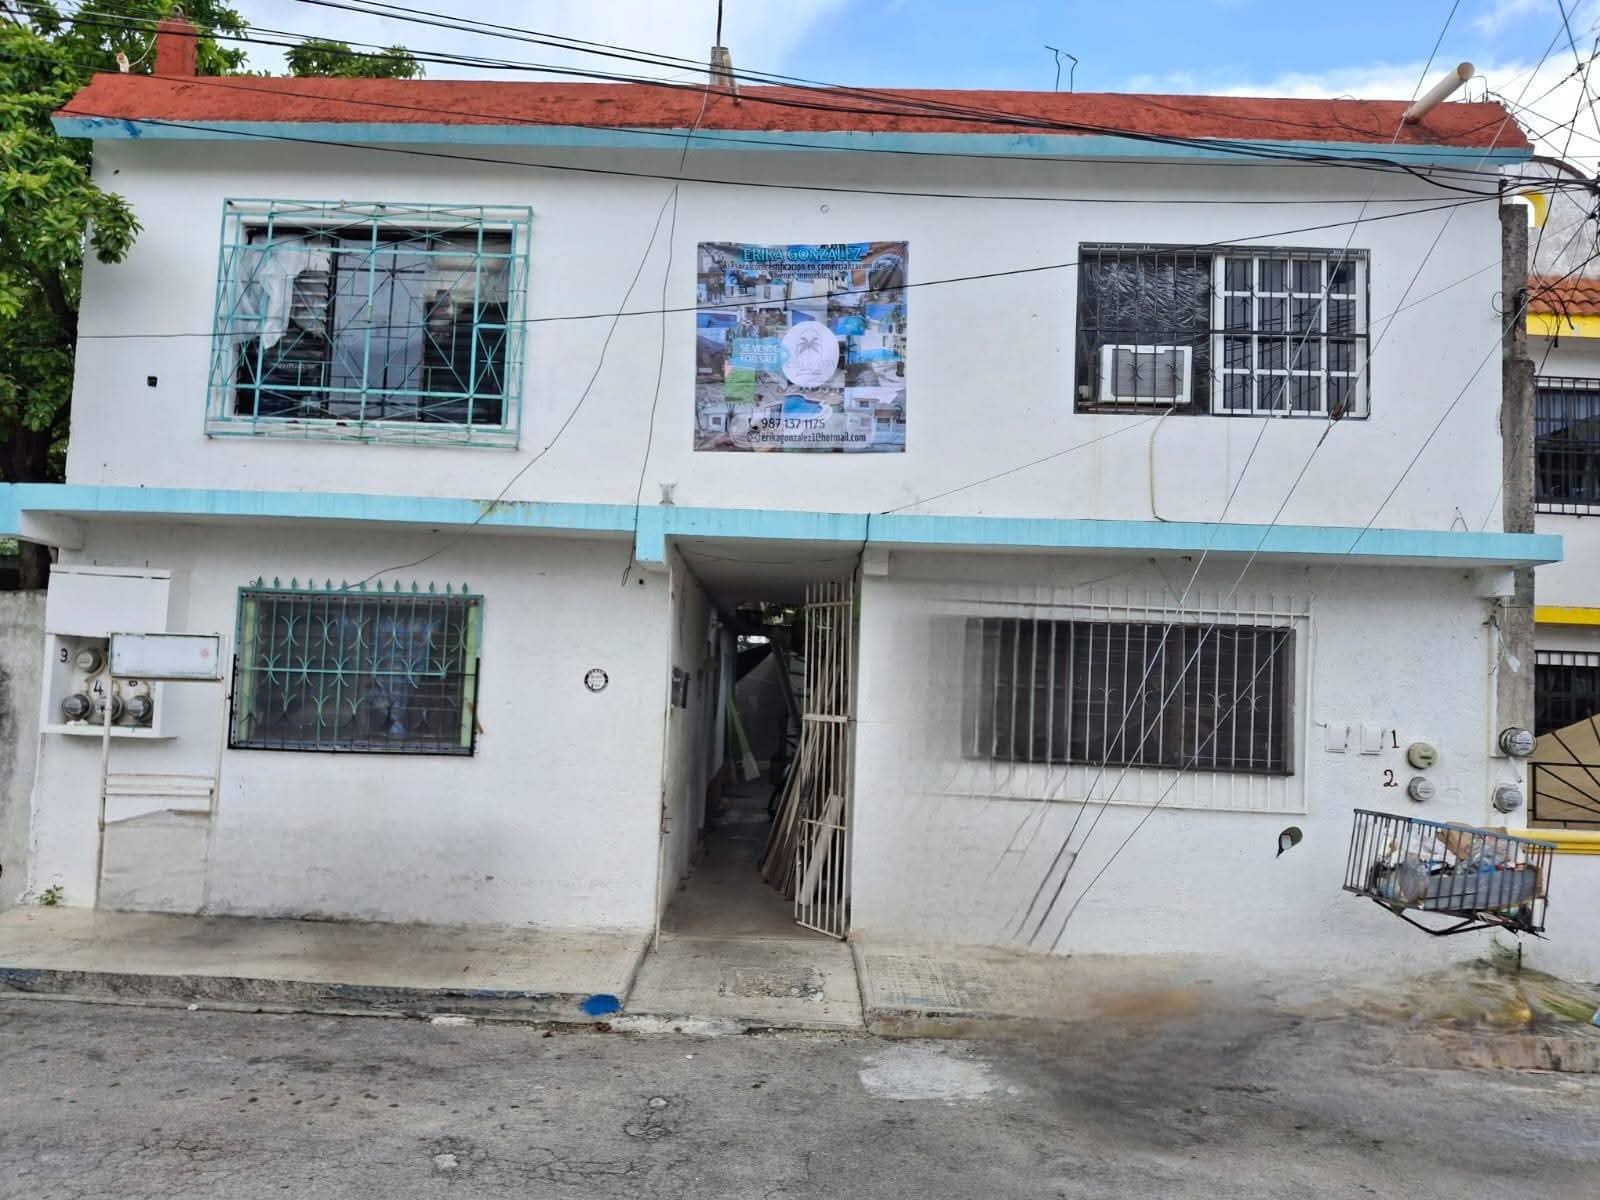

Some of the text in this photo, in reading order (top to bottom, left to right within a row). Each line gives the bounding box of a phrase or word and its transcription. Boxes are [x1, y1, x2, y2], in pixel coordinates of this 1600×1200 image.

[743, 247, 785, 261] ERIKA
[740, 344, 780, 353] SE VENDE
[761, 418, 826, 429] 987 137 1175
[93, 679, 104, 695] 4
[1391, 729, 1400, 749] 1
[1383, 769, 1398, 787] 2
